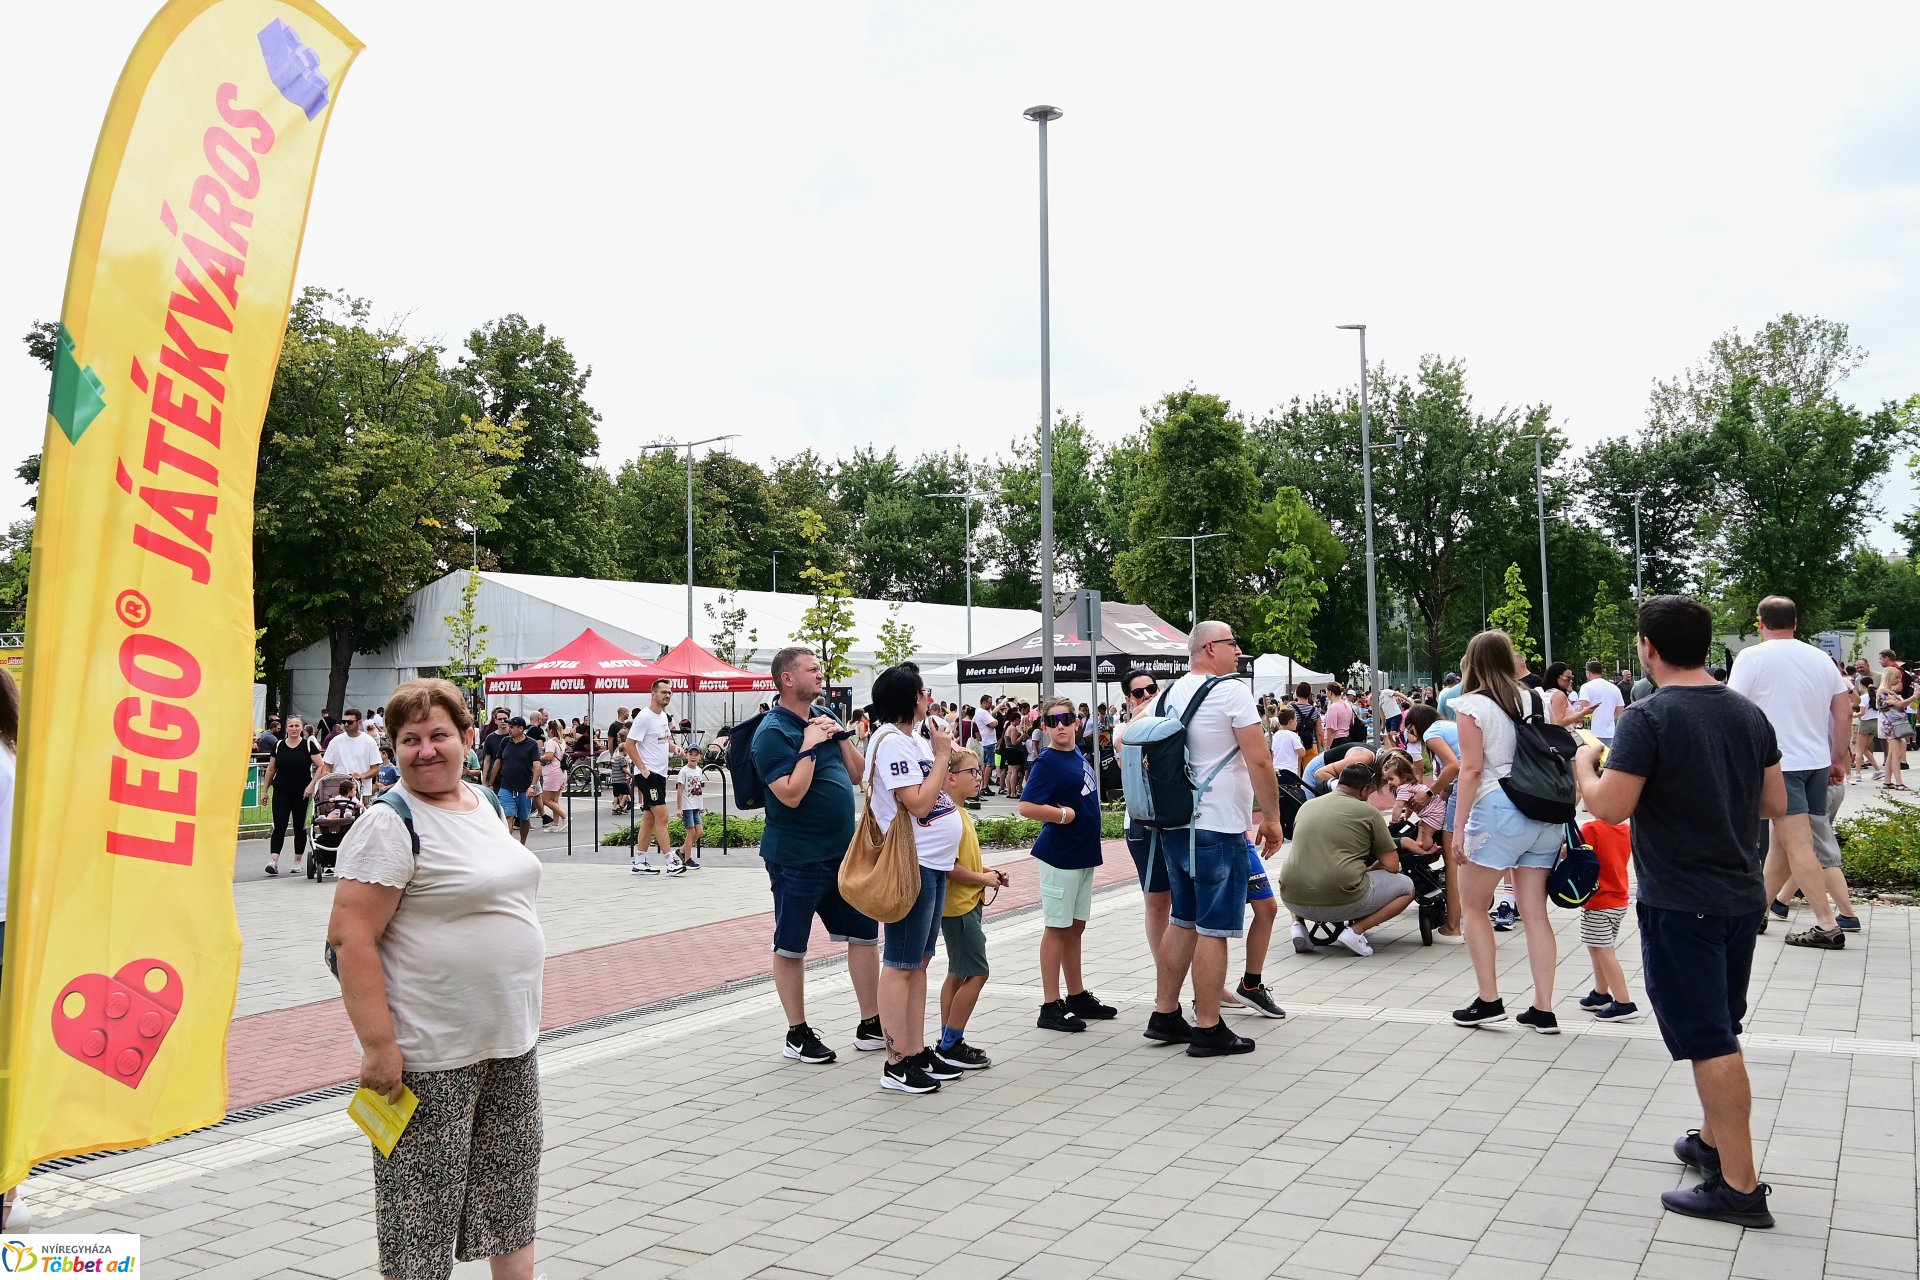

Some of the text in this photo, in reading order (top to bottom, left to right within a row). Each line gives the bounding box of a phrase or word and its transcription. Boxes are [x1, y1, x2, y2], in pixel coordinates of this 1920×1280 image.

[116, 82, 275, 585] JÁTÉKVÁROS
[529, 660, 581, 670] MOTUL
[598, 660, 648, 668] MOTUL
[1152, 659, 1173, 674] élmény
[1173, 659, 1181, 674] jár
[966, 667, 986, 676] Mert
[998, 664, 1029, 676] élmény
[489, 680, 522, 692] MOTUL
[550, 678, 586, 690] MOTUL
[594, 678, 630, 689] MOTUL
[665, 678, 689, 689] OTUL
[698, 680, 729, 690] MOTUL
[752, 679, 777, 689] MOTU
[890, 761, 909, 776] 98
